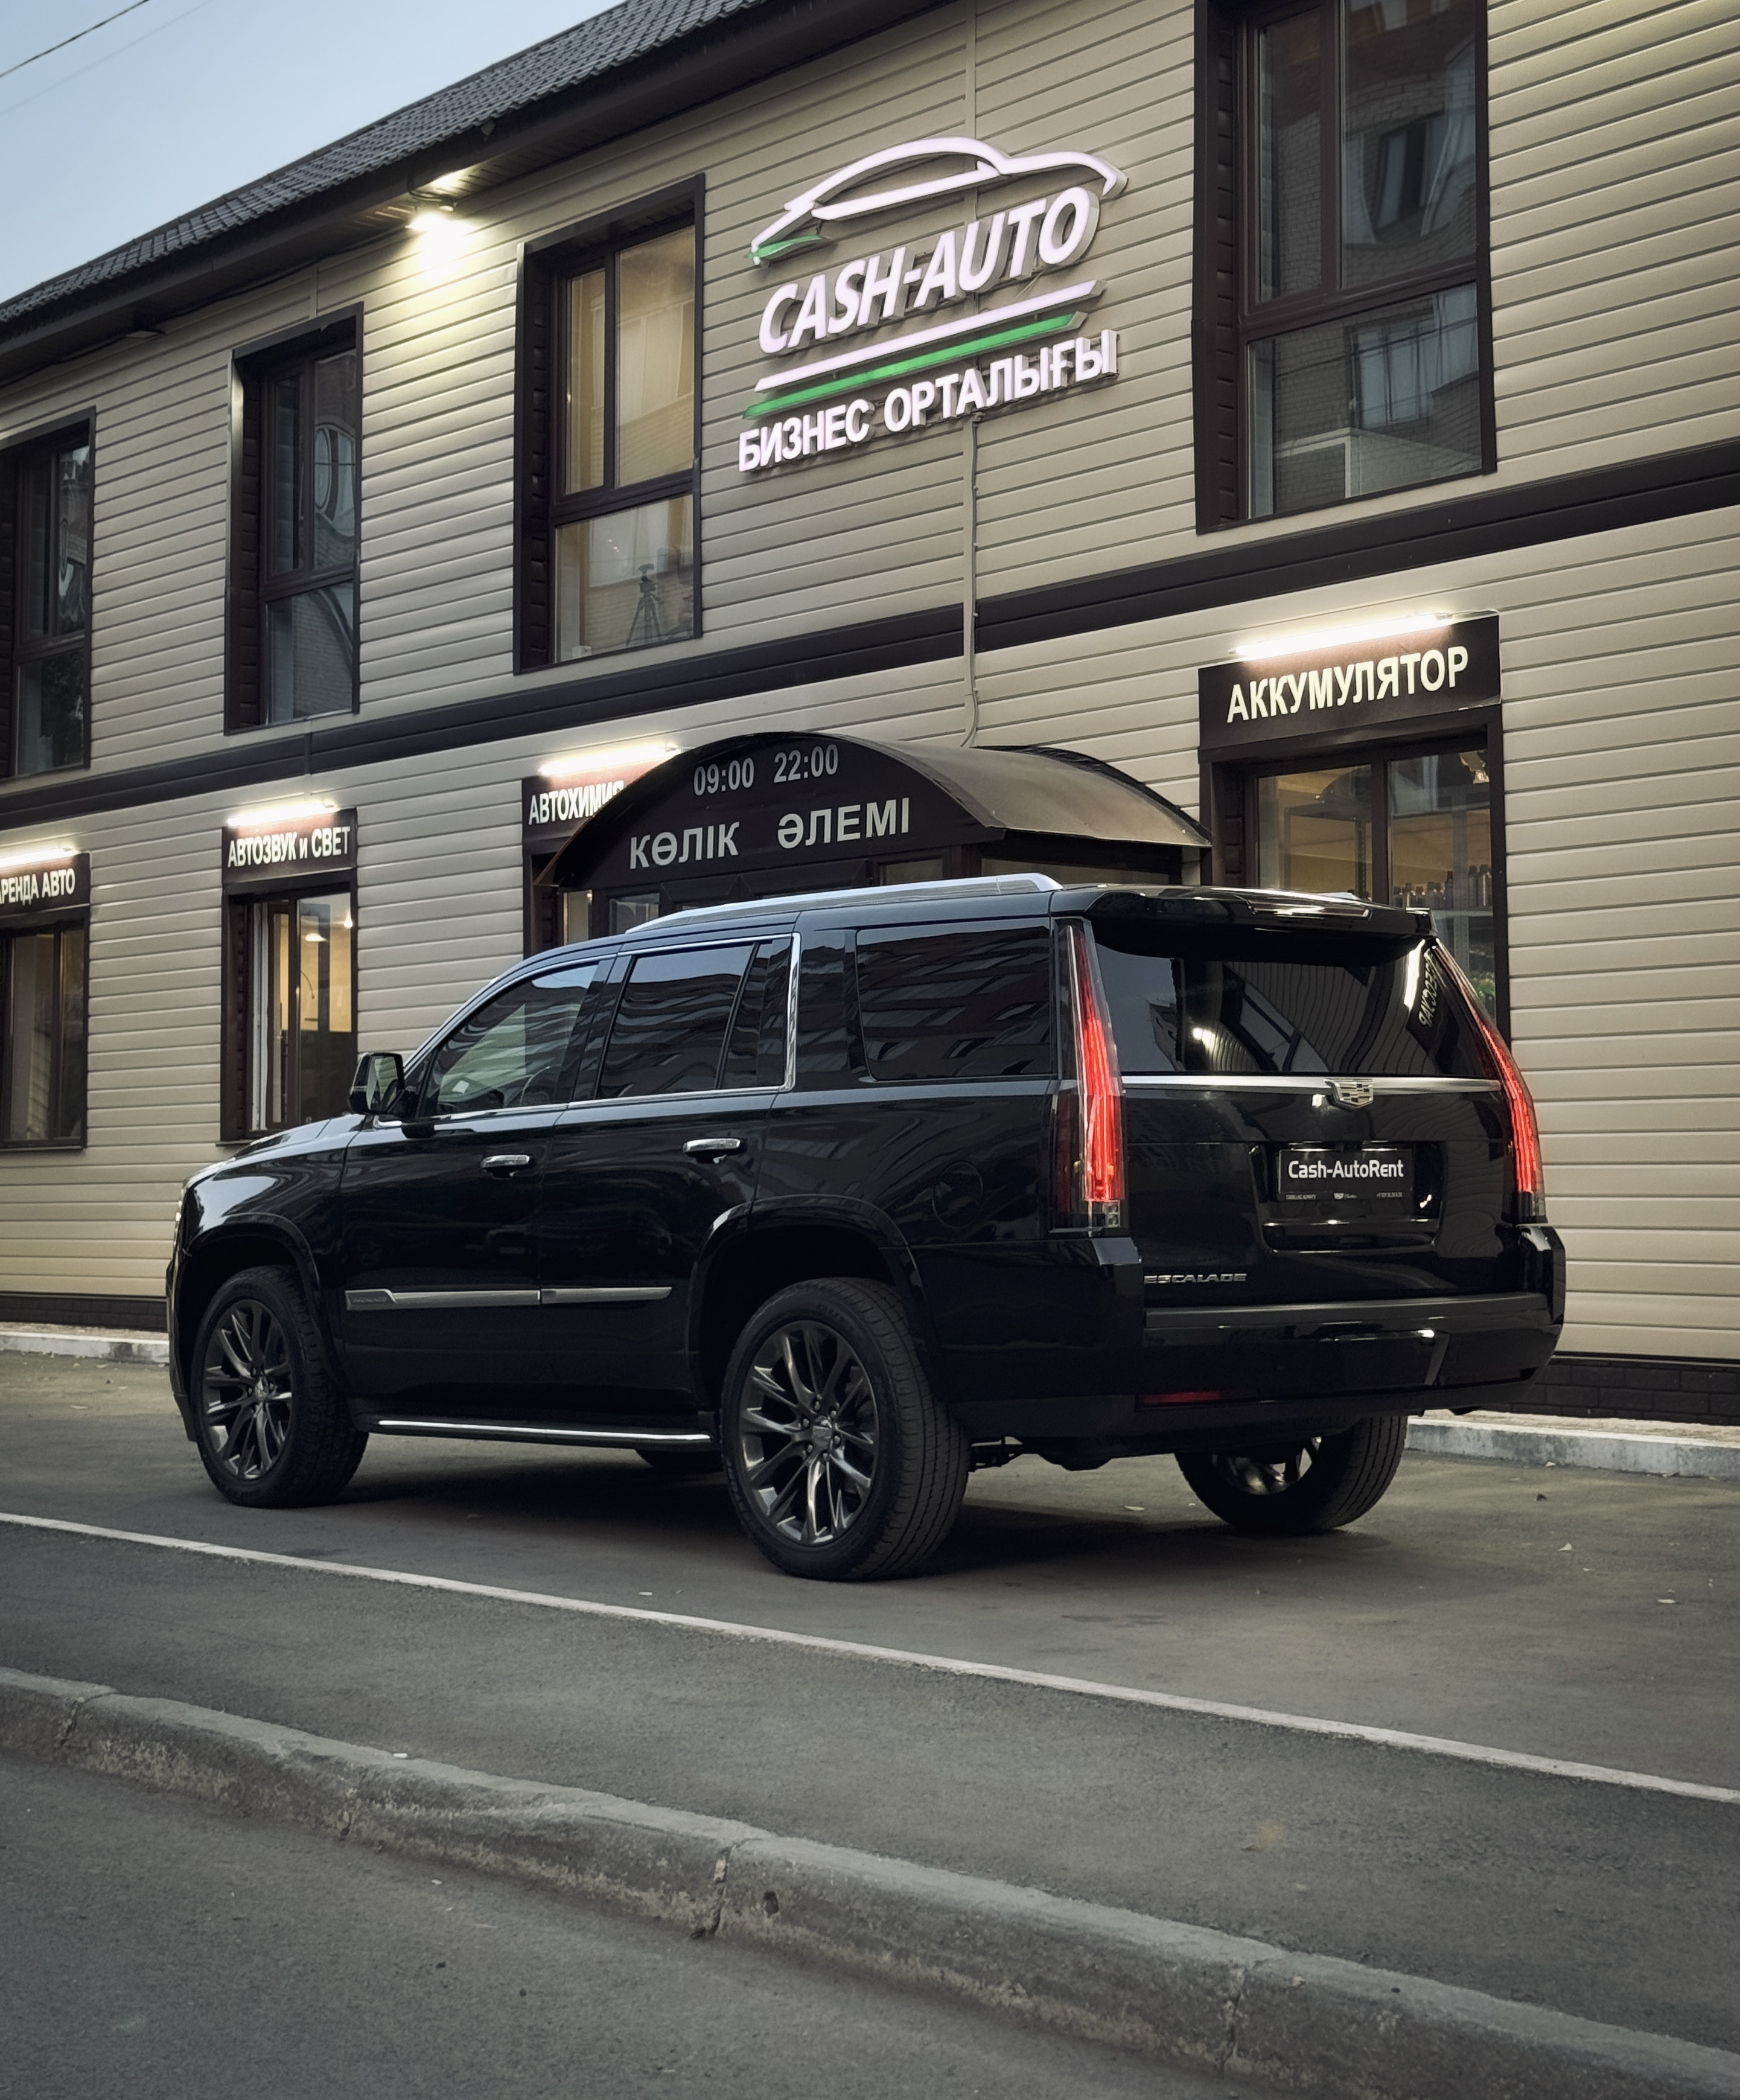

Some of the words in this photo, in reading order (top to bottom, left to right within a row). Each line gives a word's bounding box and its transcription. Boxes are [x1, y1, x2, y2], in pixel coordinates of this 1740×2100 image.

[759, 187, 1094, 354] CASH-AUTO
[738, 399, 871, 472] БИЗНЕС
[884, 328, 1118, 433] ОРТАЛЫҒЫ
[1226, 646, 1468, 723] АККУМУЛЯТОР
[693, 757, 754, 796] 09:00
[773, 744, 839, 784] 22:00
[228, 832, 298, 867] АВТОЗВУК
[311, 826, 351, 858] СВЕТ
[629, 821, 740, 870] КӨЛІК
[777, 797, 910, 849] ӘЛЕМІ
[0, 873, 39, 905] РЕНДА
[42, 868, 75, 898] АВТО
[1287, 1159, 1404, 1179] Cash-AutoRent
[1143, 1273, 1248, 1285] ESCALADE
